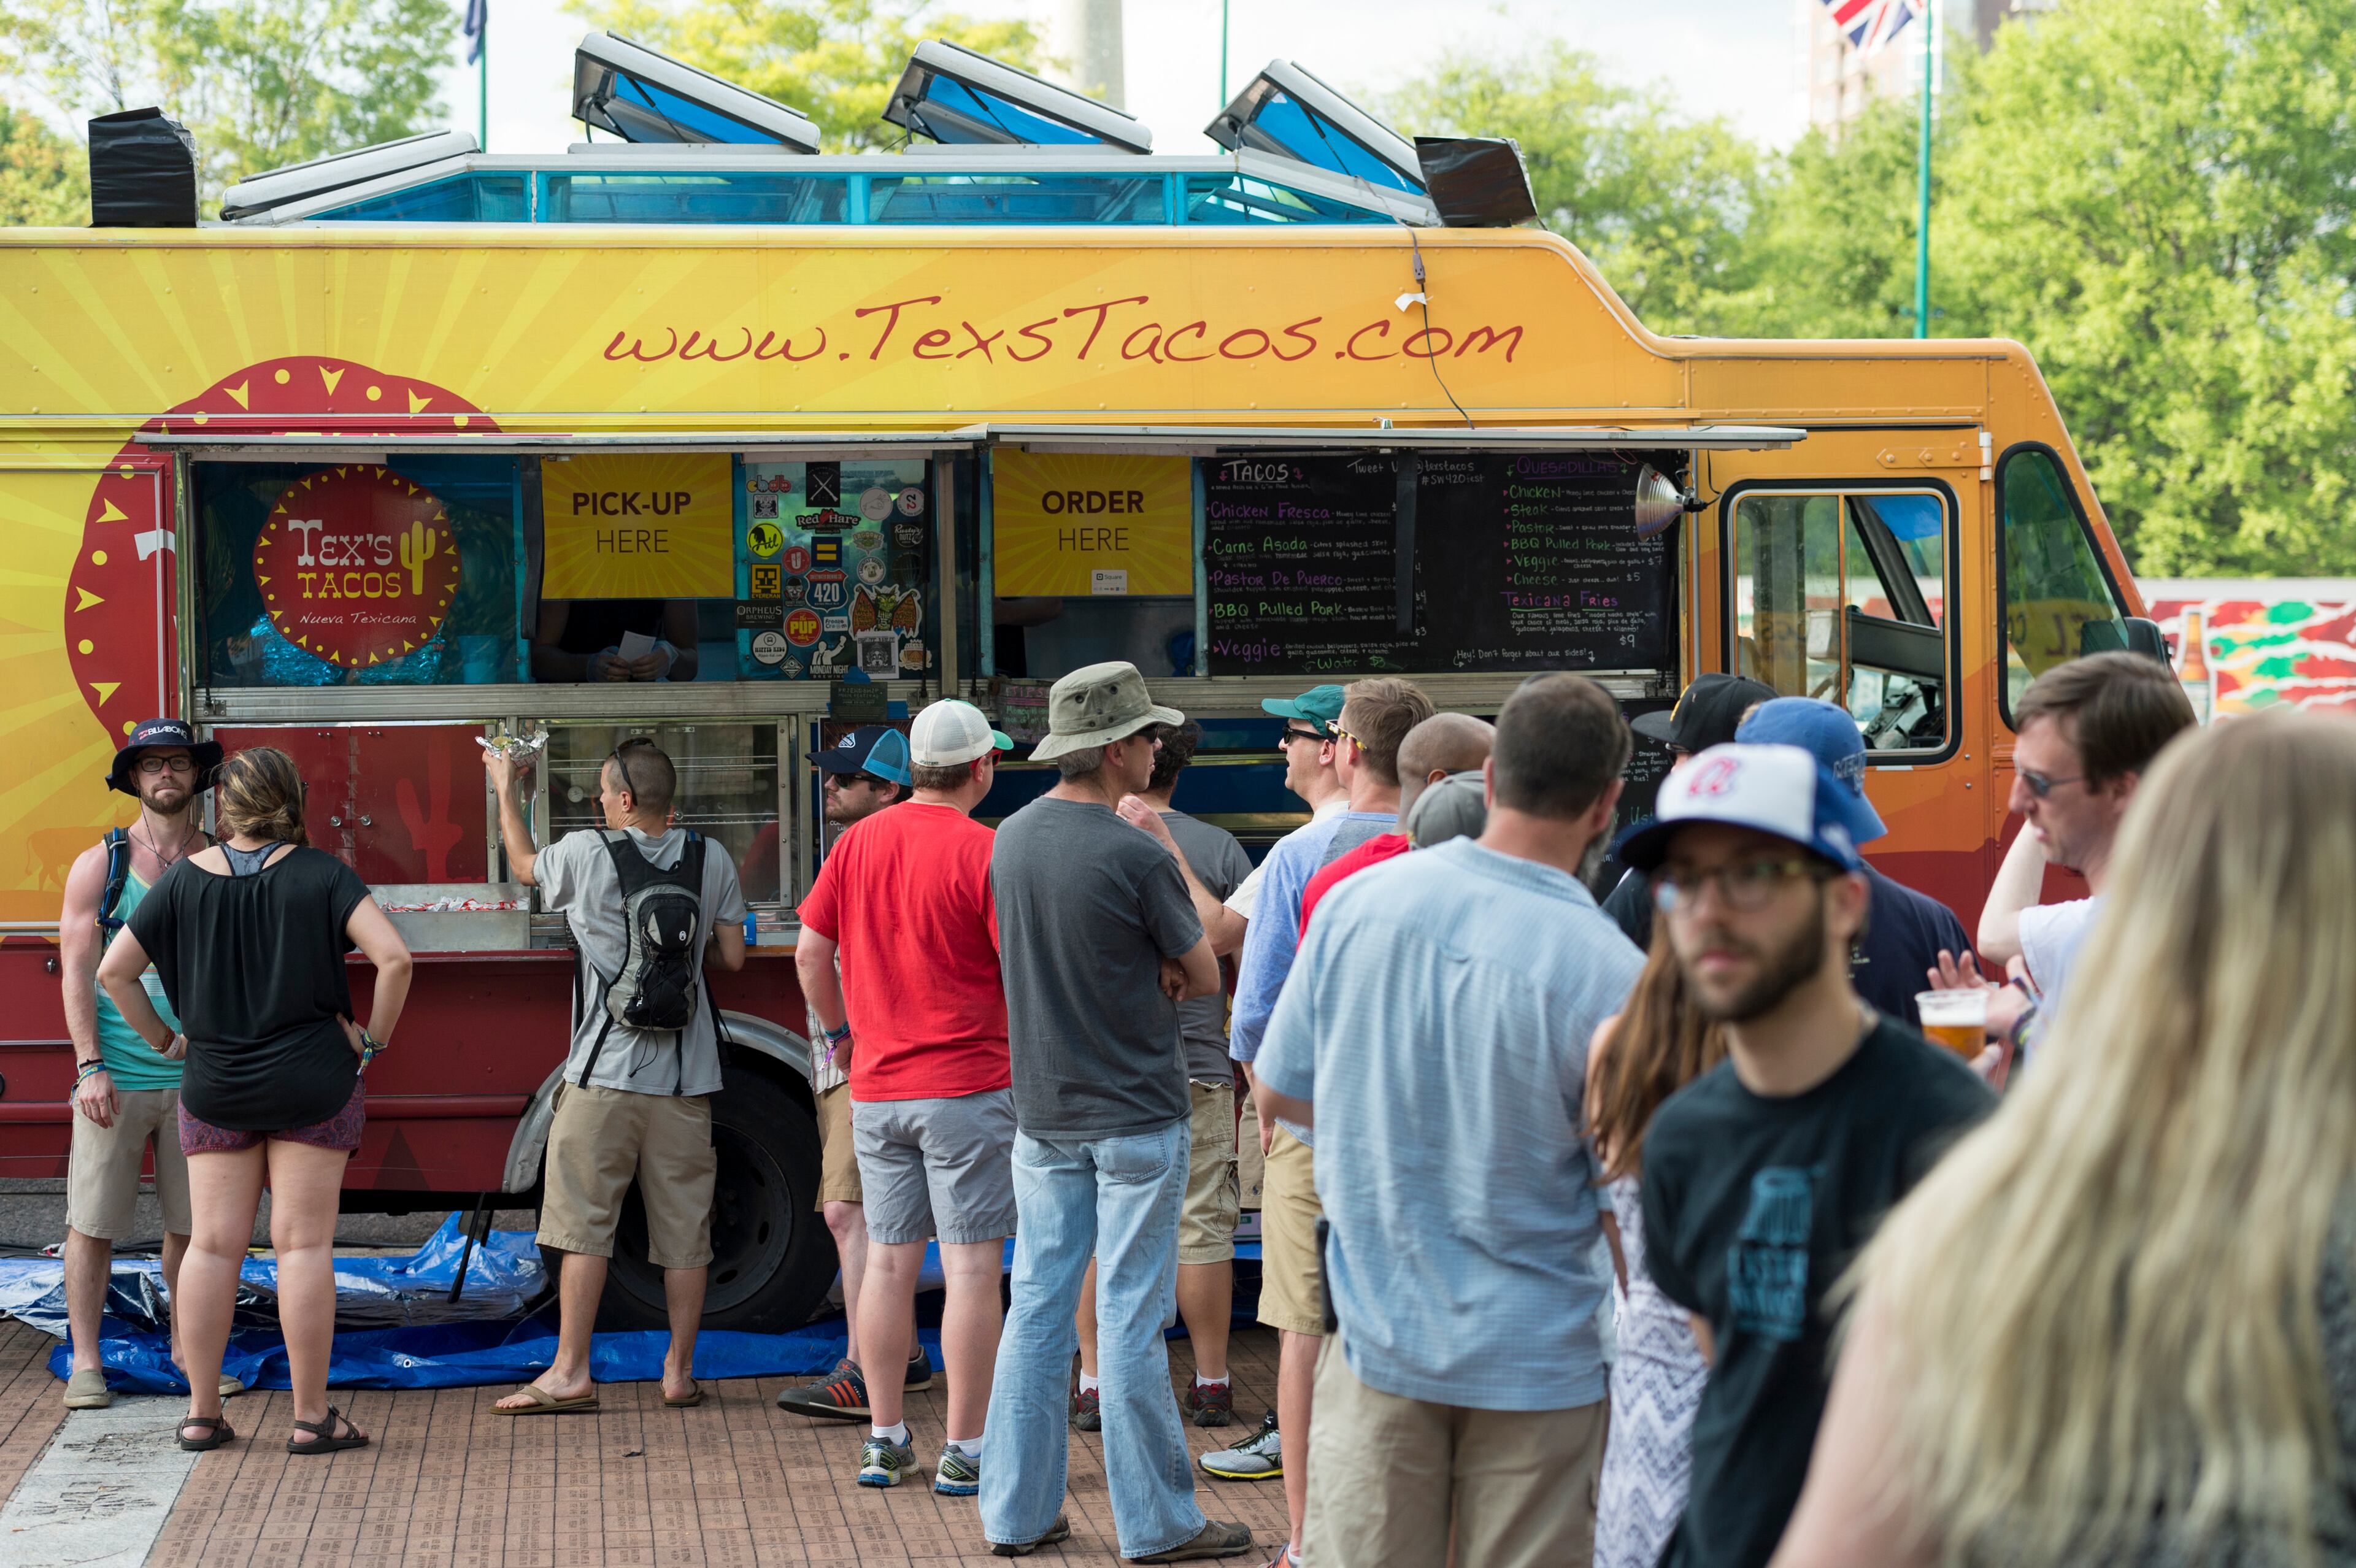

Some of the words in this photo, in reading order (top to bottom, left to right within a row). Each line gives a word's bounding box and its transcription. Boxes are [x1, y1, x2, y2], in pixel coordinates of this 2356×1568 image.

[604, 296, 1523, 364] www.TexsTacos.com
[1222, 460, 1289, 482] TACOS
[1347, 458, 1384, 474] Tweet
[1509, 485, 1561, 499] Chicken
[572, 492, 691, 515] PICK-UP
[1042, 490, 1144, 515] ORDER
[1211, 501, 1269, 518] Chicken
[1277, 502, 1330, 519] Fresca
[1511, 504, 1549, 517] Steak
[797, 515, 820, 526] Red
[830, 514, 859, 525] Hare
[1512, 520, 1555, 535] Pastor
[597, 530, 669, 553] HERE
[1059, 528, 1130, 551] HERE
[1213, 538, 1255, 555] Carne
[1263, 535, 1308, 553] Asada
[1512, 538, 1539, 550] BBQ
[1546, 537, 1579, 550] Pulled
[1586, 537, 1612, 551] Pork
[1514, 553, 1559, 572] Veggie
[1648, 555, 1663, 566] $7
[298, 572, 401, 599] TACOS
[1214, 570, 1265, 586] Pastor
[1272, 571, 1290, 586] De
[1296, 569, 1343, 586] Puerco
[1514, 572, 1558, 586] Cheese
[1626, 572, 1641, 582] $5
[814, 583, 839, 602] 420
[1499, 590, 1571, 607] Texicana
[1580, 590, 1620, 607] Fries
[299, 612, 343, 624] Nueva
[350, 612, 417, 624] Texicana
[737, 605, 782, 615] ORPHEUS
[1214, 602, 1249, 619] BBQ
[1259, 601, 1303, 617] Pulled
[1311, 601, 1343, 616] Pork
[790, 620, 817, 634] PUP
[1620, 634, 1635, 648] $9
[1217, 637, 1281, 663] Veggie
[1457, 649, 1476, 663] Hey!
[1501, 648, 1522, 662] forget
[1525, 648, 1544, 658] about
[1565, 648, 1587, 658] sides!
[810, 664, 832, 674] MONDAY
[834, 664, 849, 674] NIGHT
[1317, 656, 1358, 669] Water
[148, 726, 187, 740] BILLABONG
